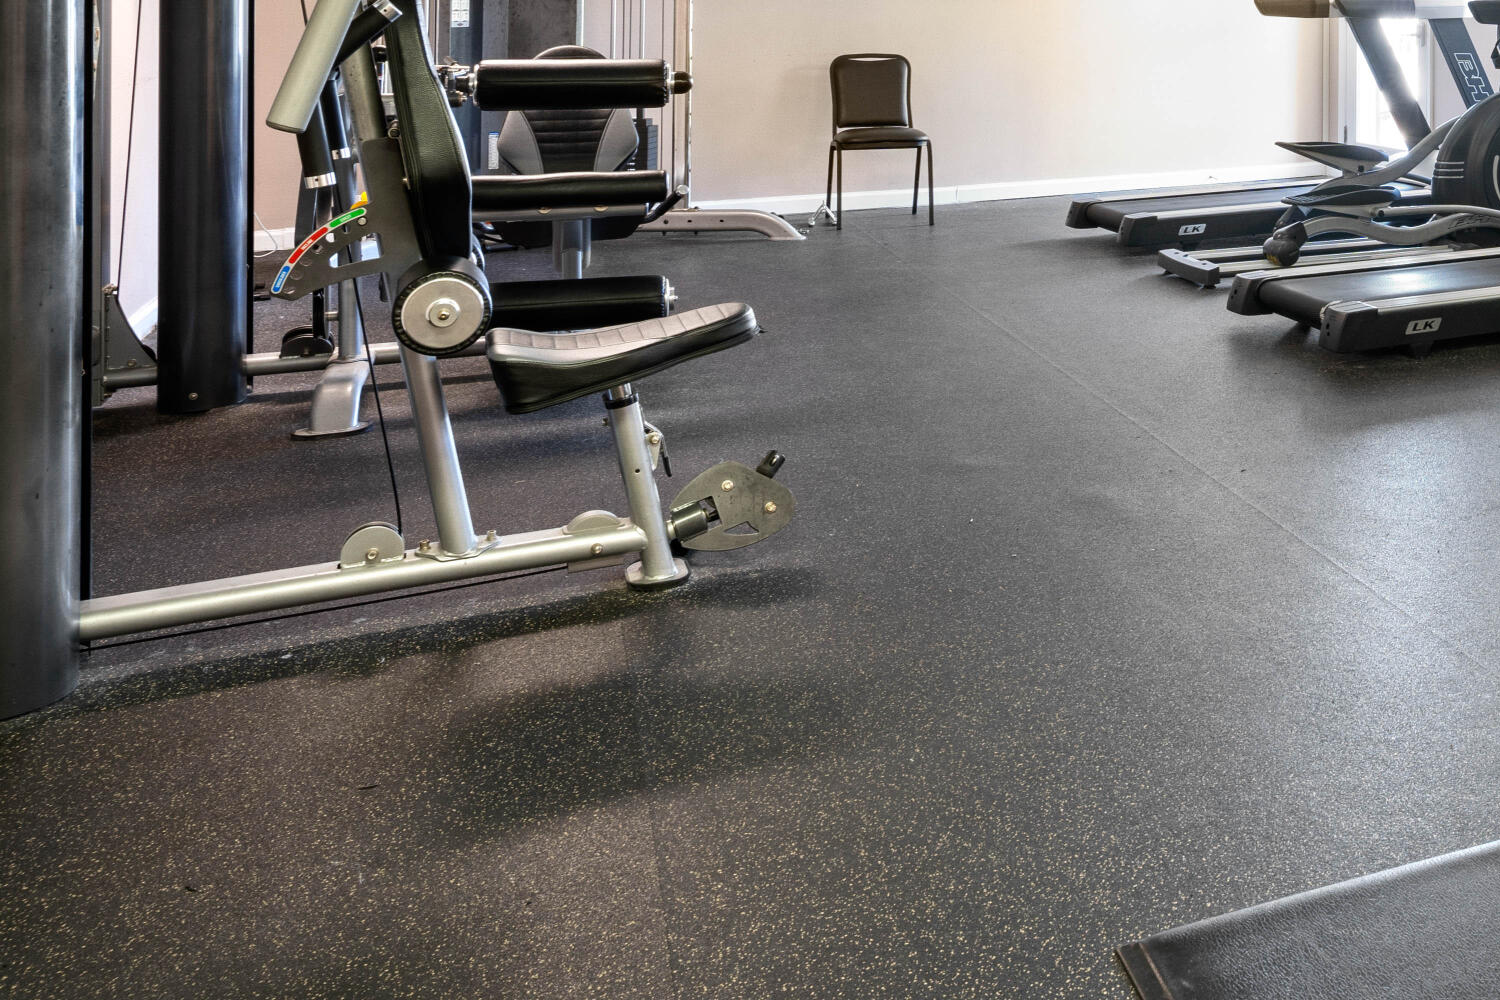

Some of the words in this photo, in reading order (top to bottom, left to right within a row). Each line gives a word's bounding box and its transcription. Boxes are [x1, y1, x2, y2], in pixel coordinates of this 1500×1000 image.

[1454, 52, 1491, 102] BH
[1184, 226, 1201, 234] LK
[1412, 320, 1436, 332] LK
